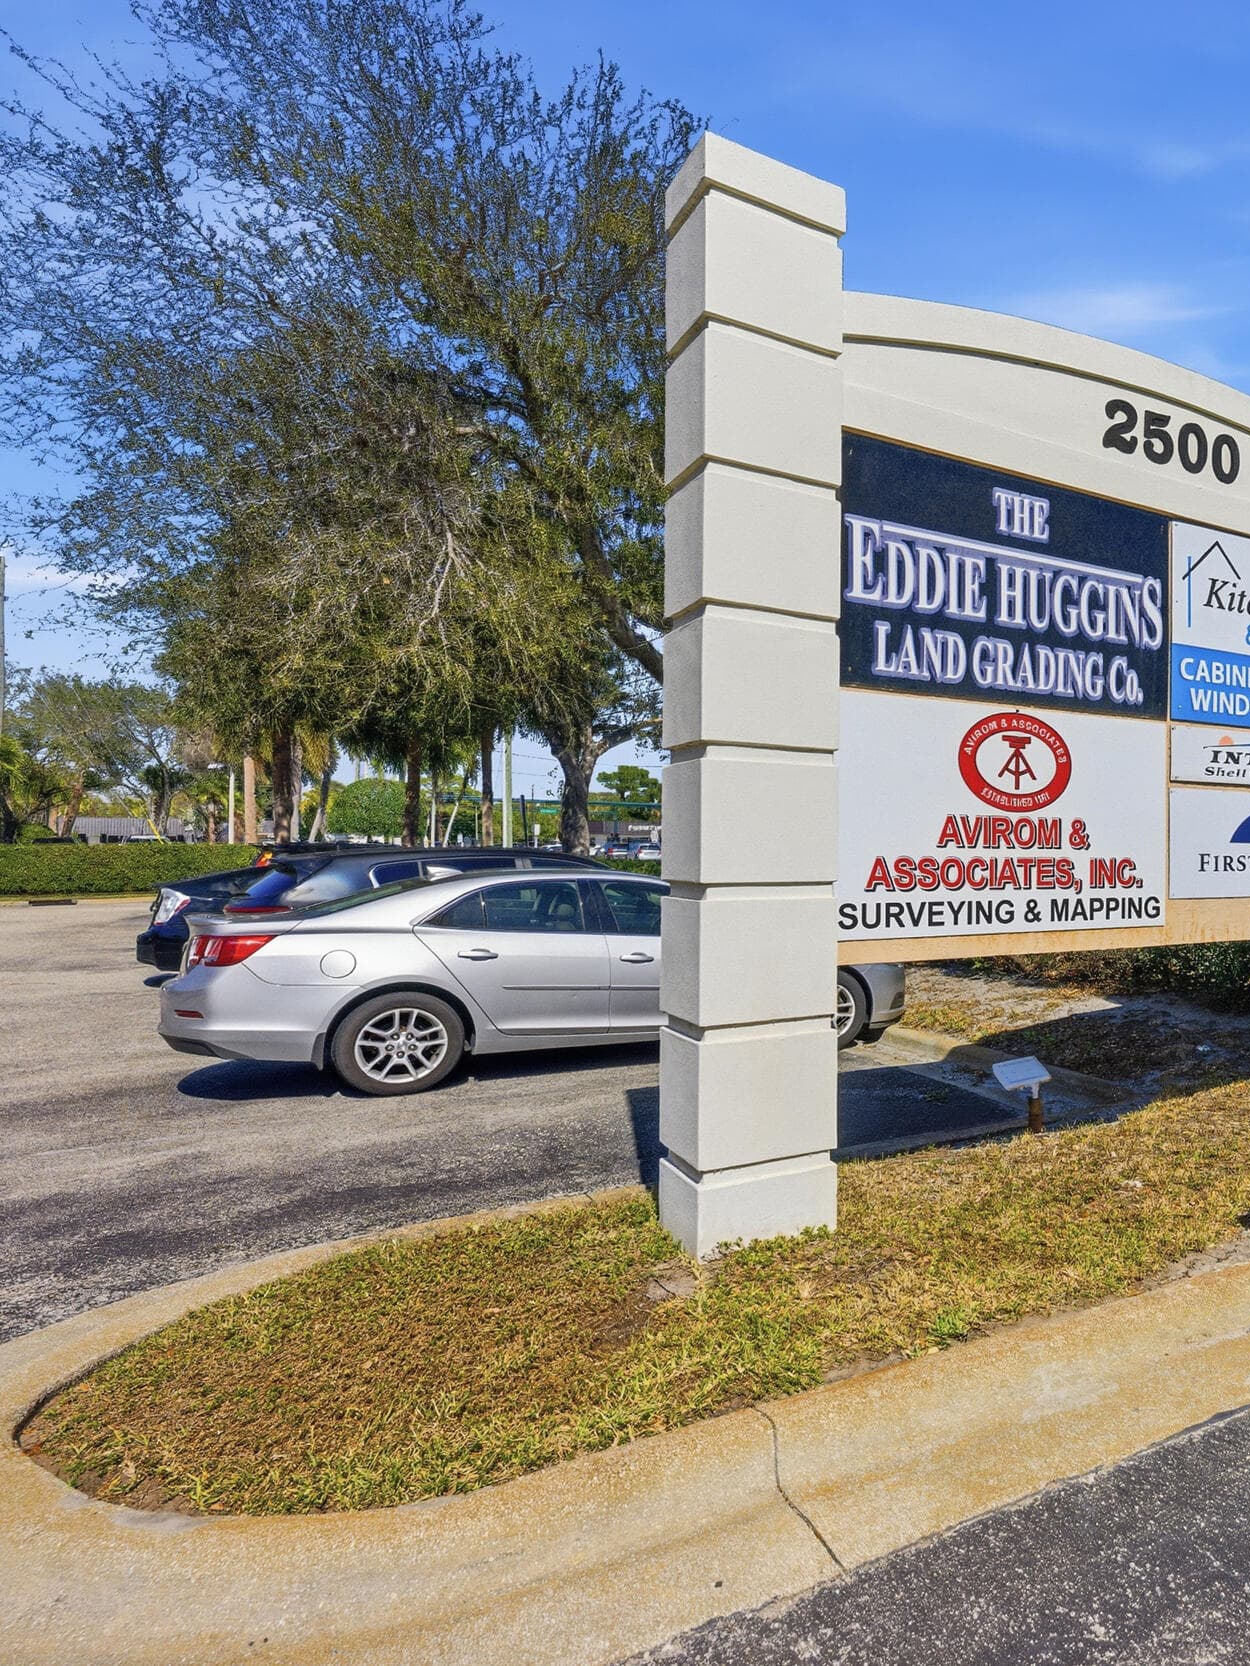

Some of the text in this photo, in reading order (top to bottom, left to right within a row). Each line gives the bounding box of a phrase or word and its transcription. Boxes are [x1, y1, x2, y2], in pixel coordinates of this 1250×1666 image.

[1102, 399, 1240, 484] 2500
[993, 487, 1050, 543] THE
[845, 513, 1163, 650] EDDIE HUGGINS
[872, 620, 967, 683] LAND
[973, 635, 1104, 701] GRADING
[963, 718, 1067, 763] AVIROM & ASSOCIATES
[1204, 766, 1247, 778] Shell
[936, 814, 1091, 850] AVIROM &
[864, 855, 1143, 894] ASSOCIATES, INC.
[837, 896, 1161, 930] SURVEYING & MAPPING
